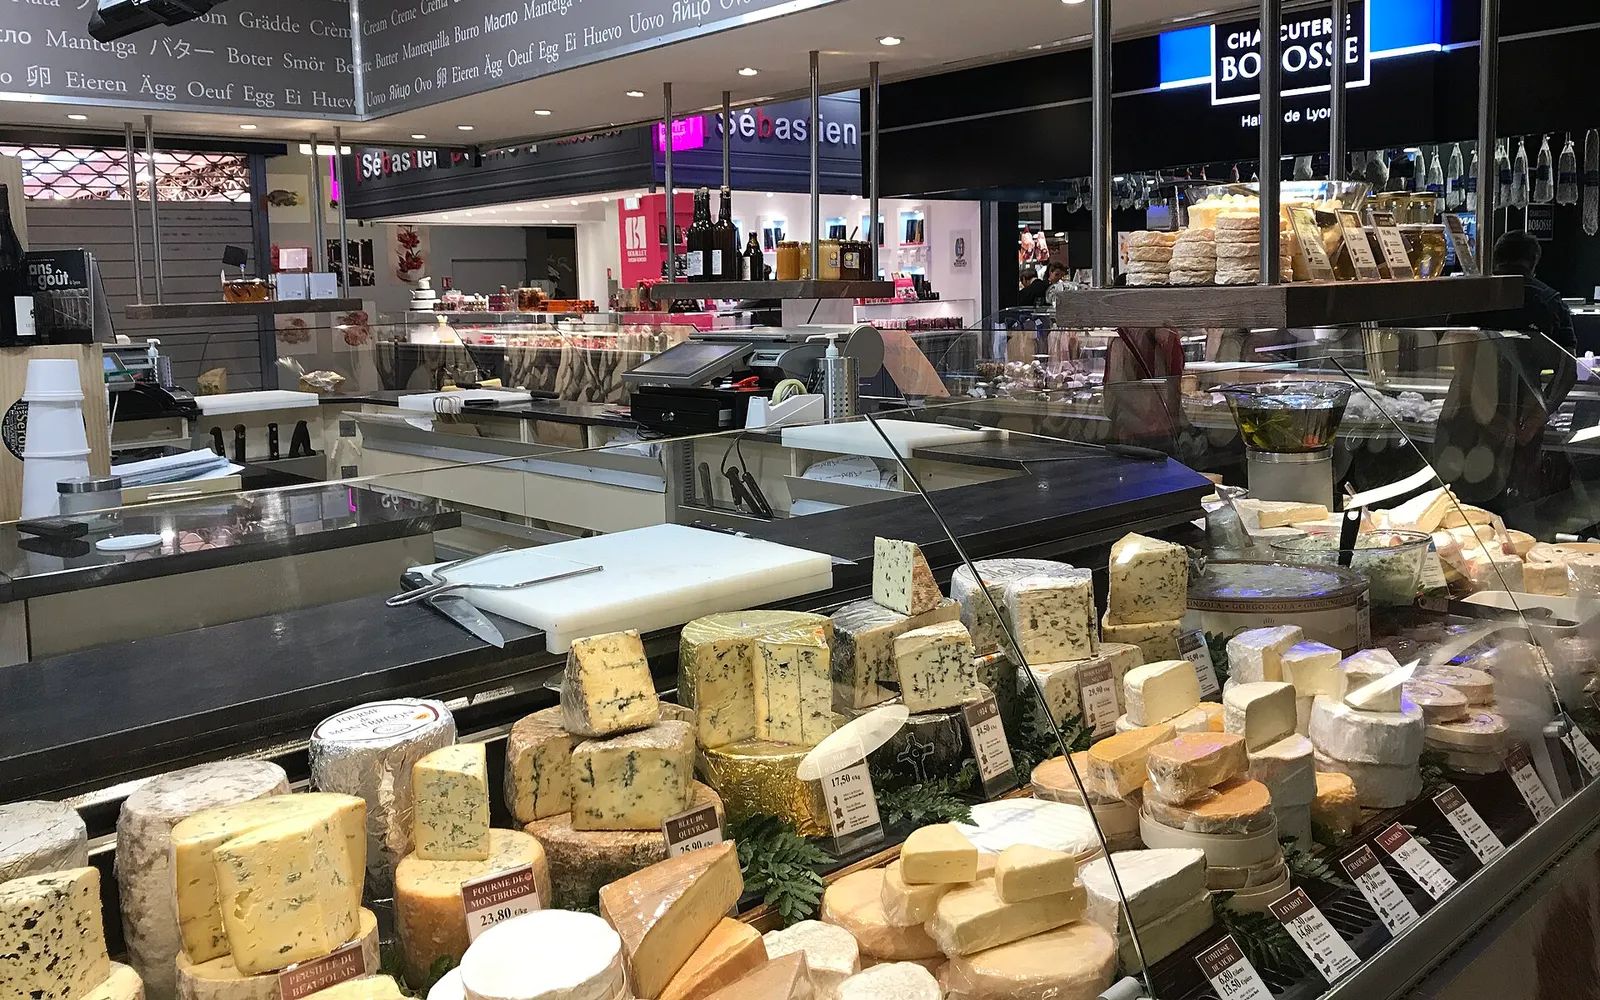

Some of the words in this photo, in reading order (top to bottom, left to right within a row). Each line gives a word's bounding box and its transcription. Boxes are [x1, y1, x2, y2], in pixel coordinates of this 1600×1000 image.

[238, 10, 300, 34] Grädde
[309, 19, 353, 39] Crèm
[363, 19, 388, 37] Cream
[375, 51, 399, 69] Butter
[402, 31, 450, 60] Mantequilla
[454, 25, 480, 44] Burro
[484, 10, 518, 34] Масло
[46, 29, 137, 59] Manteiga
[150, 36, 214, 60] バター
[227, 47, 273, 68] Boter
[283, 53, 326, 73] Smör
[365, 91, 387, 108] Uovo
[389, 83, 411, 101] Яйцо
[414, 77, 433, 94] Ovo
[436, 67, 447, 89] 卵
[452, 66, 480, 84] Eieren
[484, 53, 503, 79] Ägg
[508, 43, 534, 68] Oeuf
[538, 40, 559, 63] Egg
[564, 32, 577, 53] Ei
[584, 25, 622, 47] Huevo
[629, 12, 665, 35] Uovo
[672, 0, 711, 24] Яйцо
[27, 65, 51, 88] 卵
[65, 71, 128, 93] Eieren
[139, 74, 177, 101] Ägg
[187, 80, 235, 101] Oeuf
[243, 85, 276, 108] Egg
[285, 88, 302, 106] Ei
[717, 107, 857, 146] Sébasien
[1284, 110, 1301, 123] de
[37, 268, 69, 290] goût
[1186, 600, 1222, 609] ONZOLA
[1231, 601, 1295, 610] GORGONZOLA
[336, 708, 381, 724] FOURME
[977, 706, 988, 717] 1924
[328, 709, 416, 737] MONTBRISON
[831, 773, 851, 788] 17,50
[678, 822, 709, 840] QUEYRAS
[472, 878, 511, 897] FOURME
[512, 874, 525, 885] DE
[471, 884, 531, 909] MONTBRISON
[1279, 897, 1303, 915] LIVAROT
[480, 907, 512, 927] 23,80
[1204, 943, 1230, 964] COMTESSE
[1219, 953, 1236, 968] VICHY
[289, 957, 340, 985] PERSILLÉ
[340, 952, 356, 966] DU
[1217, 970, 1234, 985] 6,80
[291, 965, 357, 997] BEAUJOLAIS
[1222, 978, 1242, 997] 13,50
